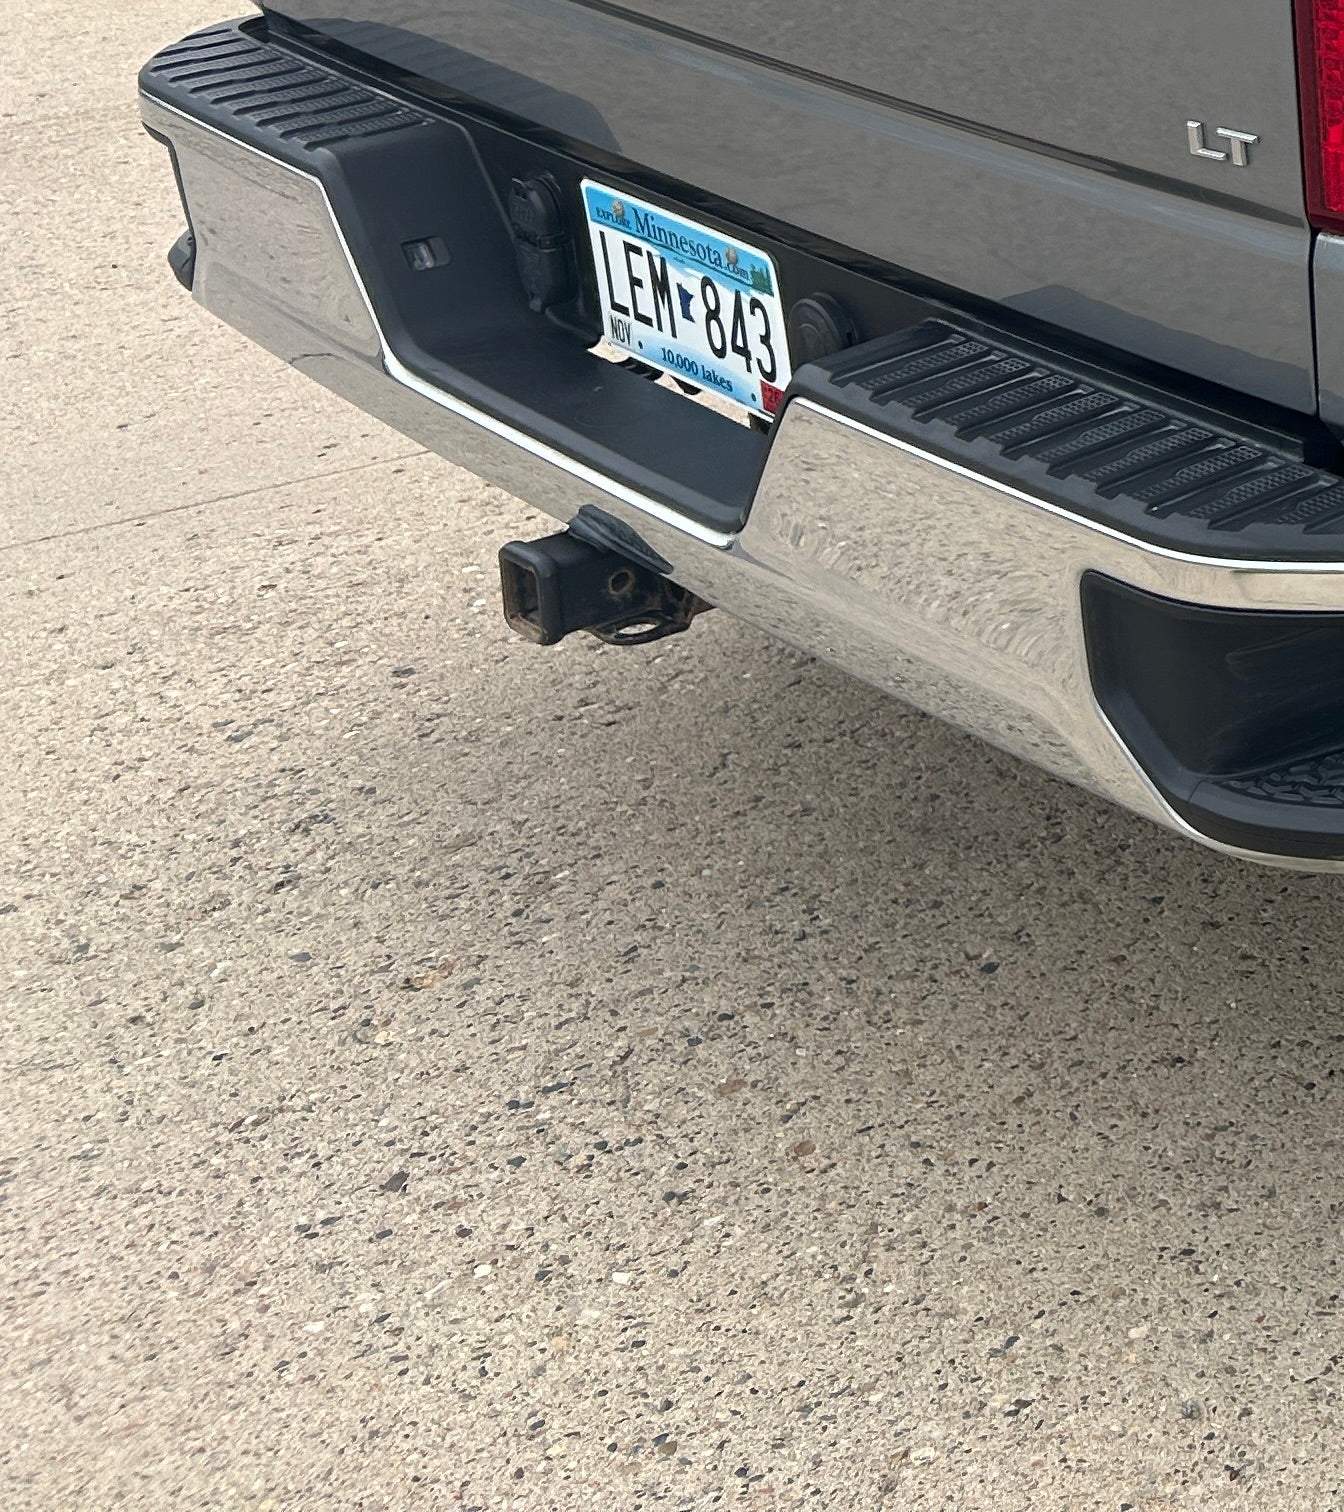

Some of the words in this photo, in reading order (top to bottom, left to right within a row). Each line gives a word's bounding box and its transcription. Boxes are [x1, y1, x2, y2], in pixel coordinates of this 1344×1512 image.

[1186, 120, 1260, 167] LT
[599, 230, 677, 339] LEM
[700, 275, 777, 383] 843
[609, 314, 632, 347] NOV
[661, 346, 698, 376] 10,000
[701, 365, 734, 393] lakes
